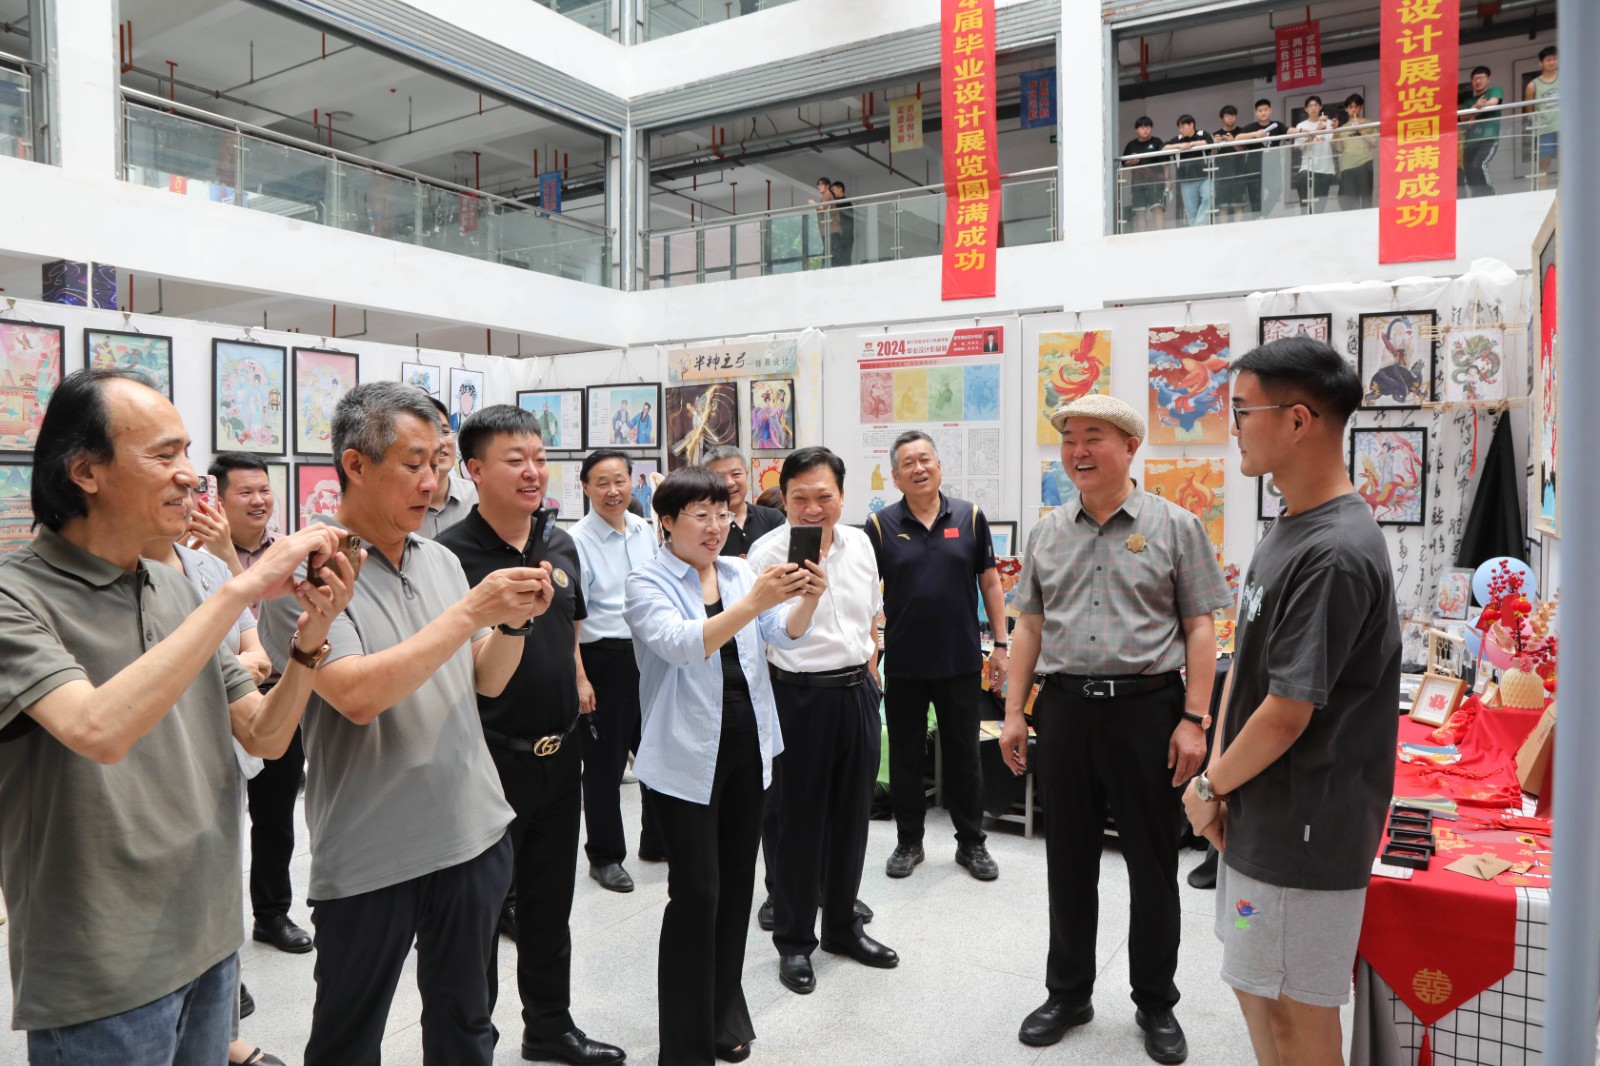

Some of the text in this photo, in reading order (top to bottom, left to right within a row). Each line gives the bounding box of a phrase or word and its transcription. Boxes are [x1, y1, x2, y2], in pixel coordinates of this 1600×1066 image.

[1395, 0, 1443, 228] 设计展览圆满成功
[877, 340, 906, 356] 2024
